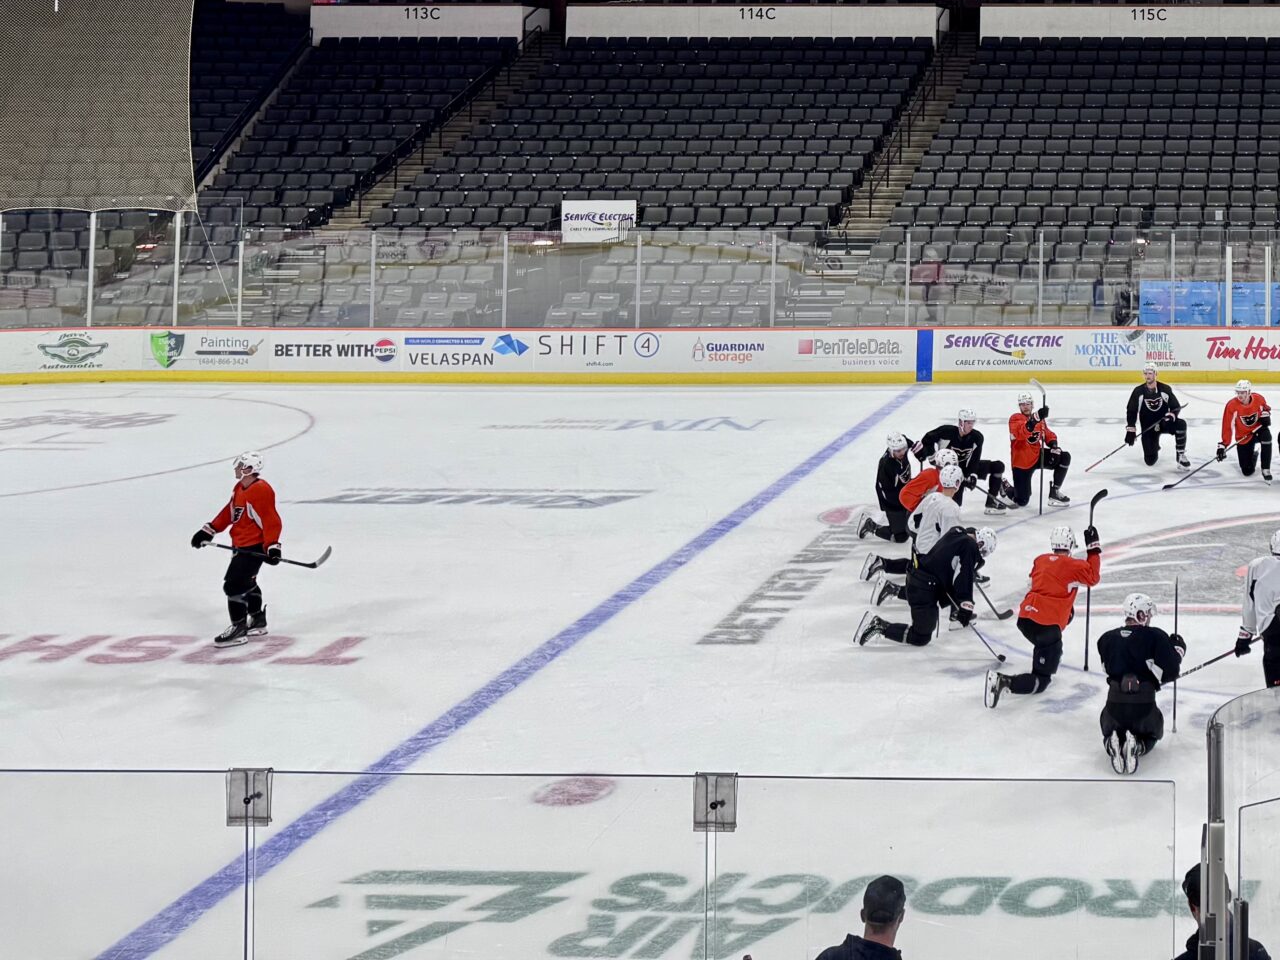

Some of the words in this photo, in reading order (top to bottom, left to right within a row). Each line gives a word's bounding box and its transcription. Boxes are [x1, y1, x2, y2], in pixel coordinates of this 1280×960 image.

[404, 7, 441, 20] 113C
[739, 8, 776, 20] 114C
[1131, 8, 1167, 21] 115C
[564, 212, 596, 221] SERVICE
[200, 337, 249, 350] Painting
[943, 332, 1000, 349] SERVICE
[1004, 333, 1064, 349] ELECTRIC
[1091, 332, 1119, 344] THE
[274, 344, 332, 357] BETTER
[342, 344, 375, 357] WITH
[375, 347, 396, 355] PEPSI
[538, 334, 628, 356] SHIFT
[641, 337, 651, 353] 4
[706, 342, 765, 352] GUARDIAN
[814, 338, 900, 355] PenTeleData
[1074, 344, 1136, 356] MORNING
[1206, 336, 1240, 360] Tim
[409, 352, 494, 366] VELASPAN
[708, 352, 753, 364] storage
[842, 358, 876, 366] business
[878, 358, 900, 366] voice
[1088, 355, 1122, 367] CALL
[1145, 351, 1176, 361] MOBILE.
[39, 362, 103, 370] Automotive
[548, 915, 806, 960] AIR
